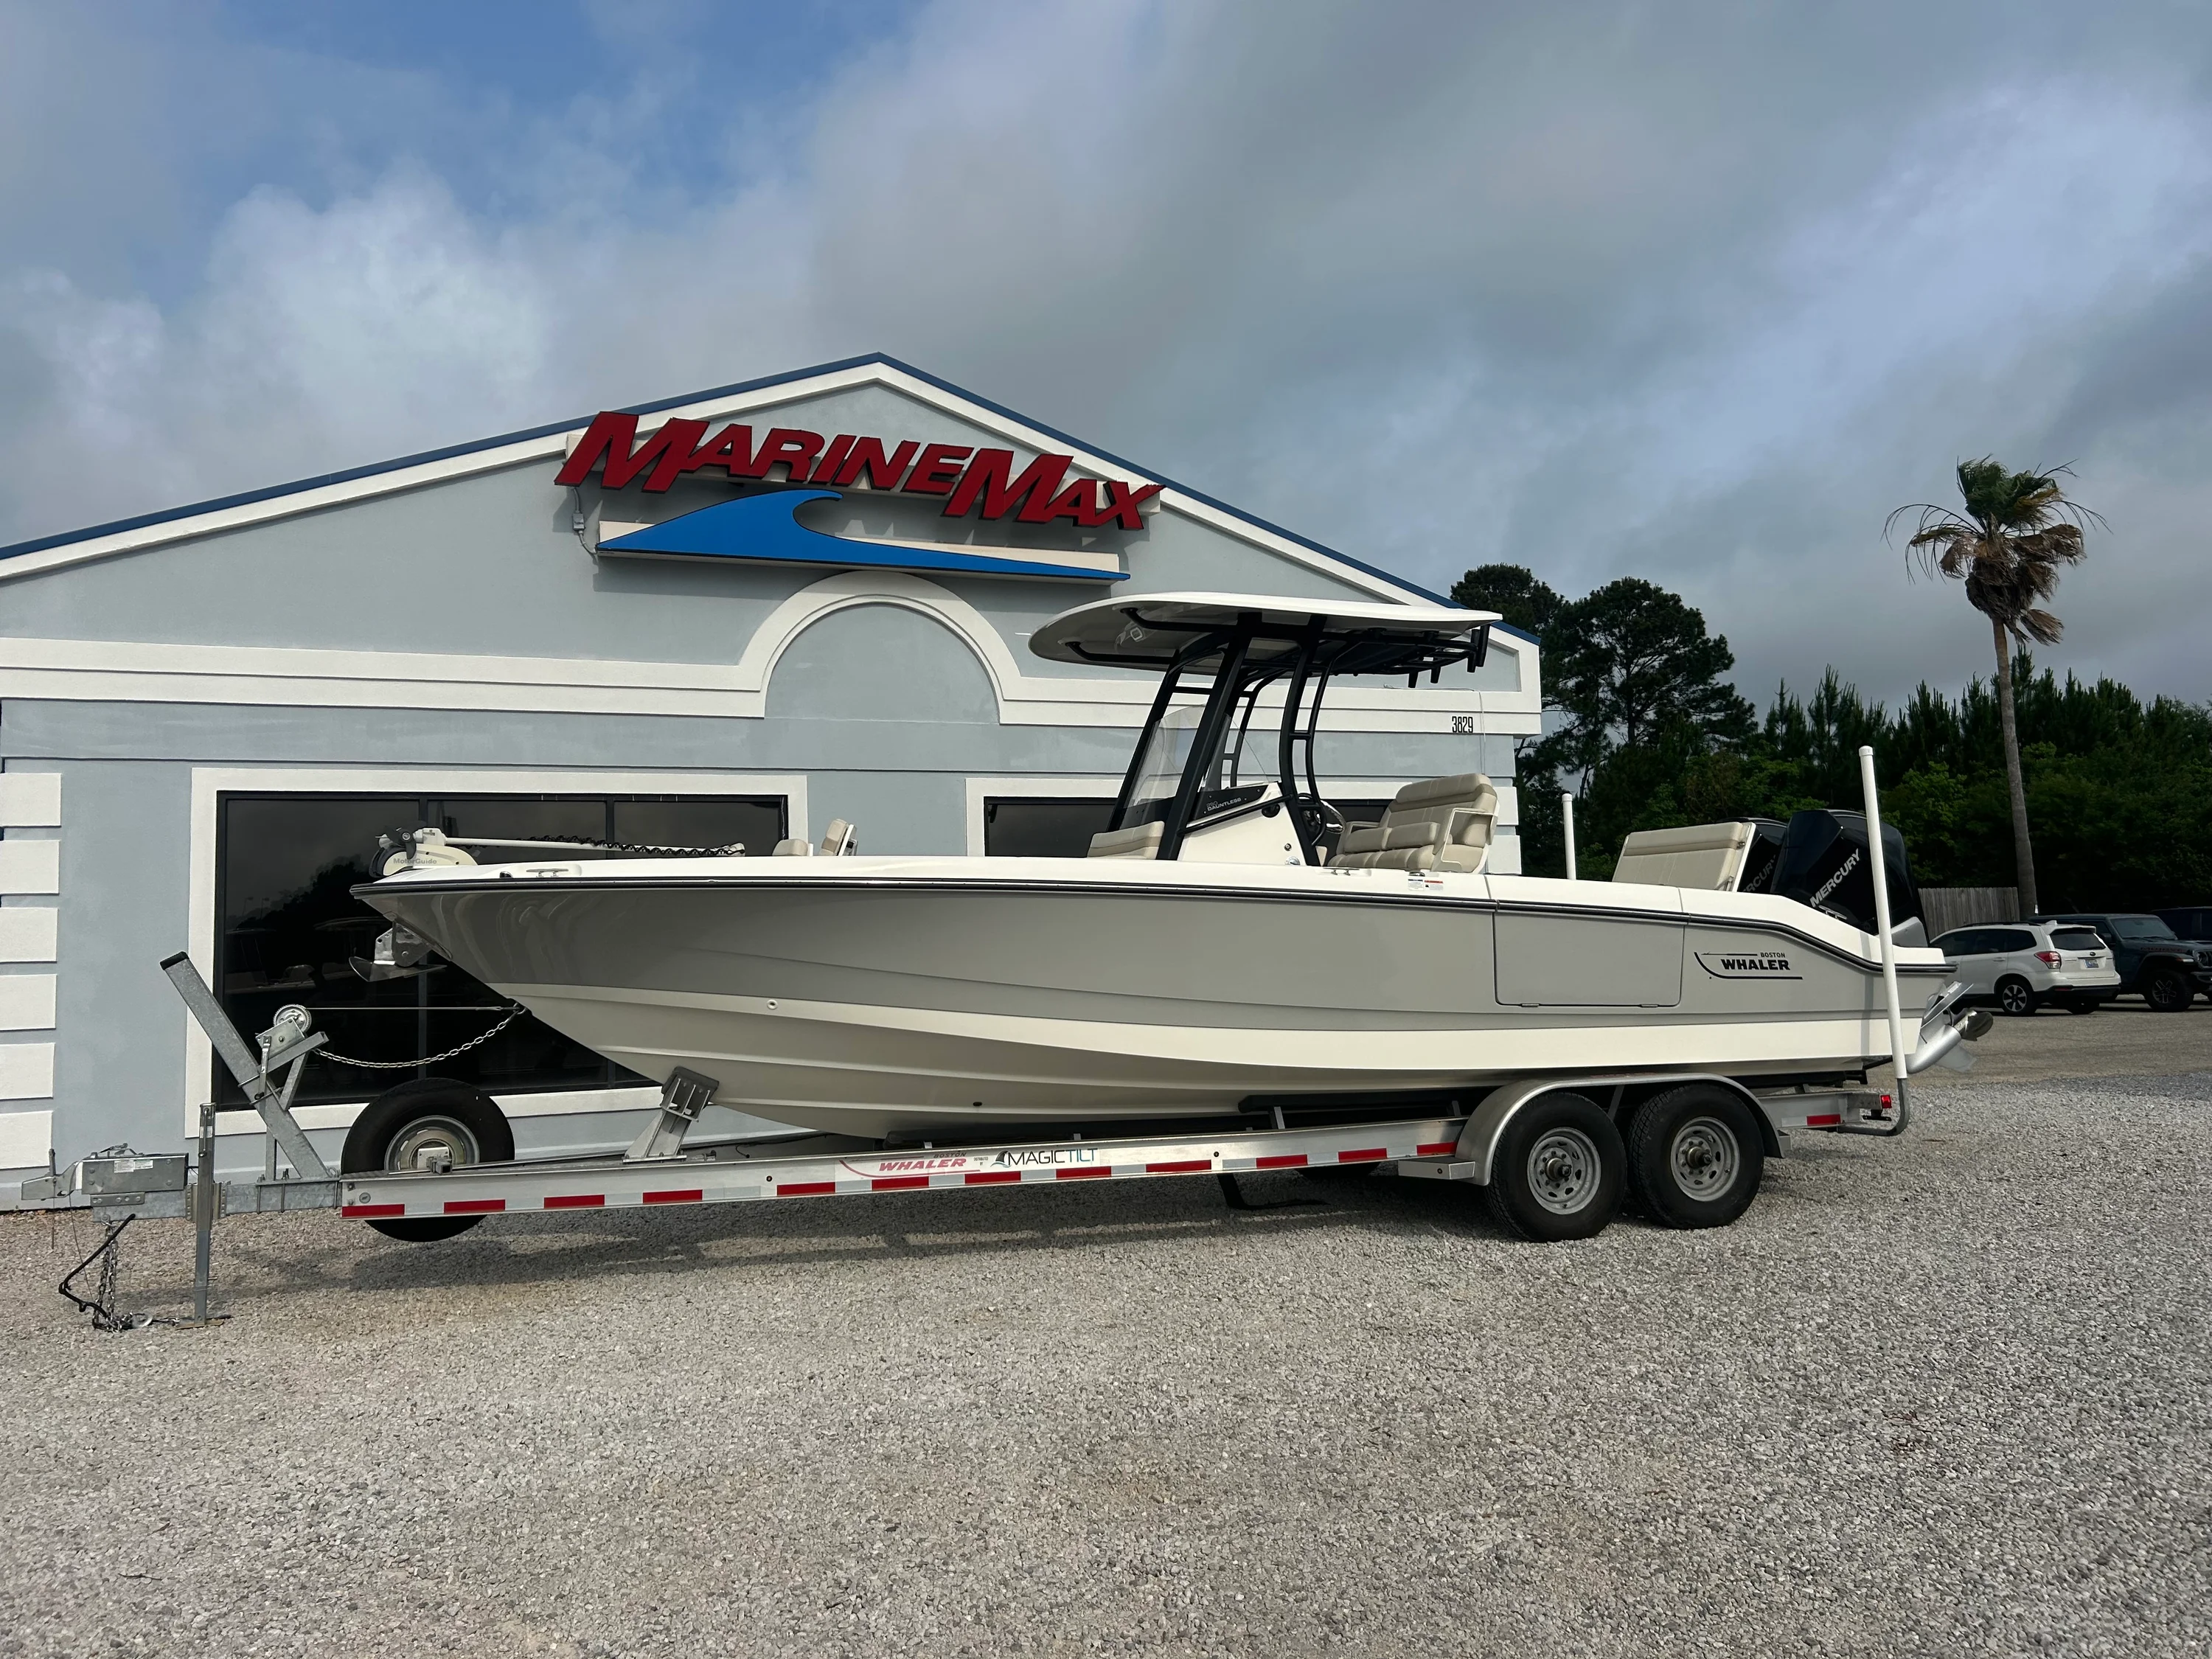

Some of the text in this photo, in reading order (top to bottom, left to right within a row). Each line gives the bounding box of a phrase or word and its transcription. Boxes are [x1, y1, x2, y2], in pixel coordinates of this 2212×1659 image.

[1452, 716, 1473, 734] 3829
[1207, 797, 1242, 811] DAUNTLESS
[1809, 848, 1860, 908] MERCURY
[1720, 959, 1791, 970] WHALER
[1008, 1148, 1098, 1165] MAGICTILT
[879, 1158, 967, 1172] WHALER
